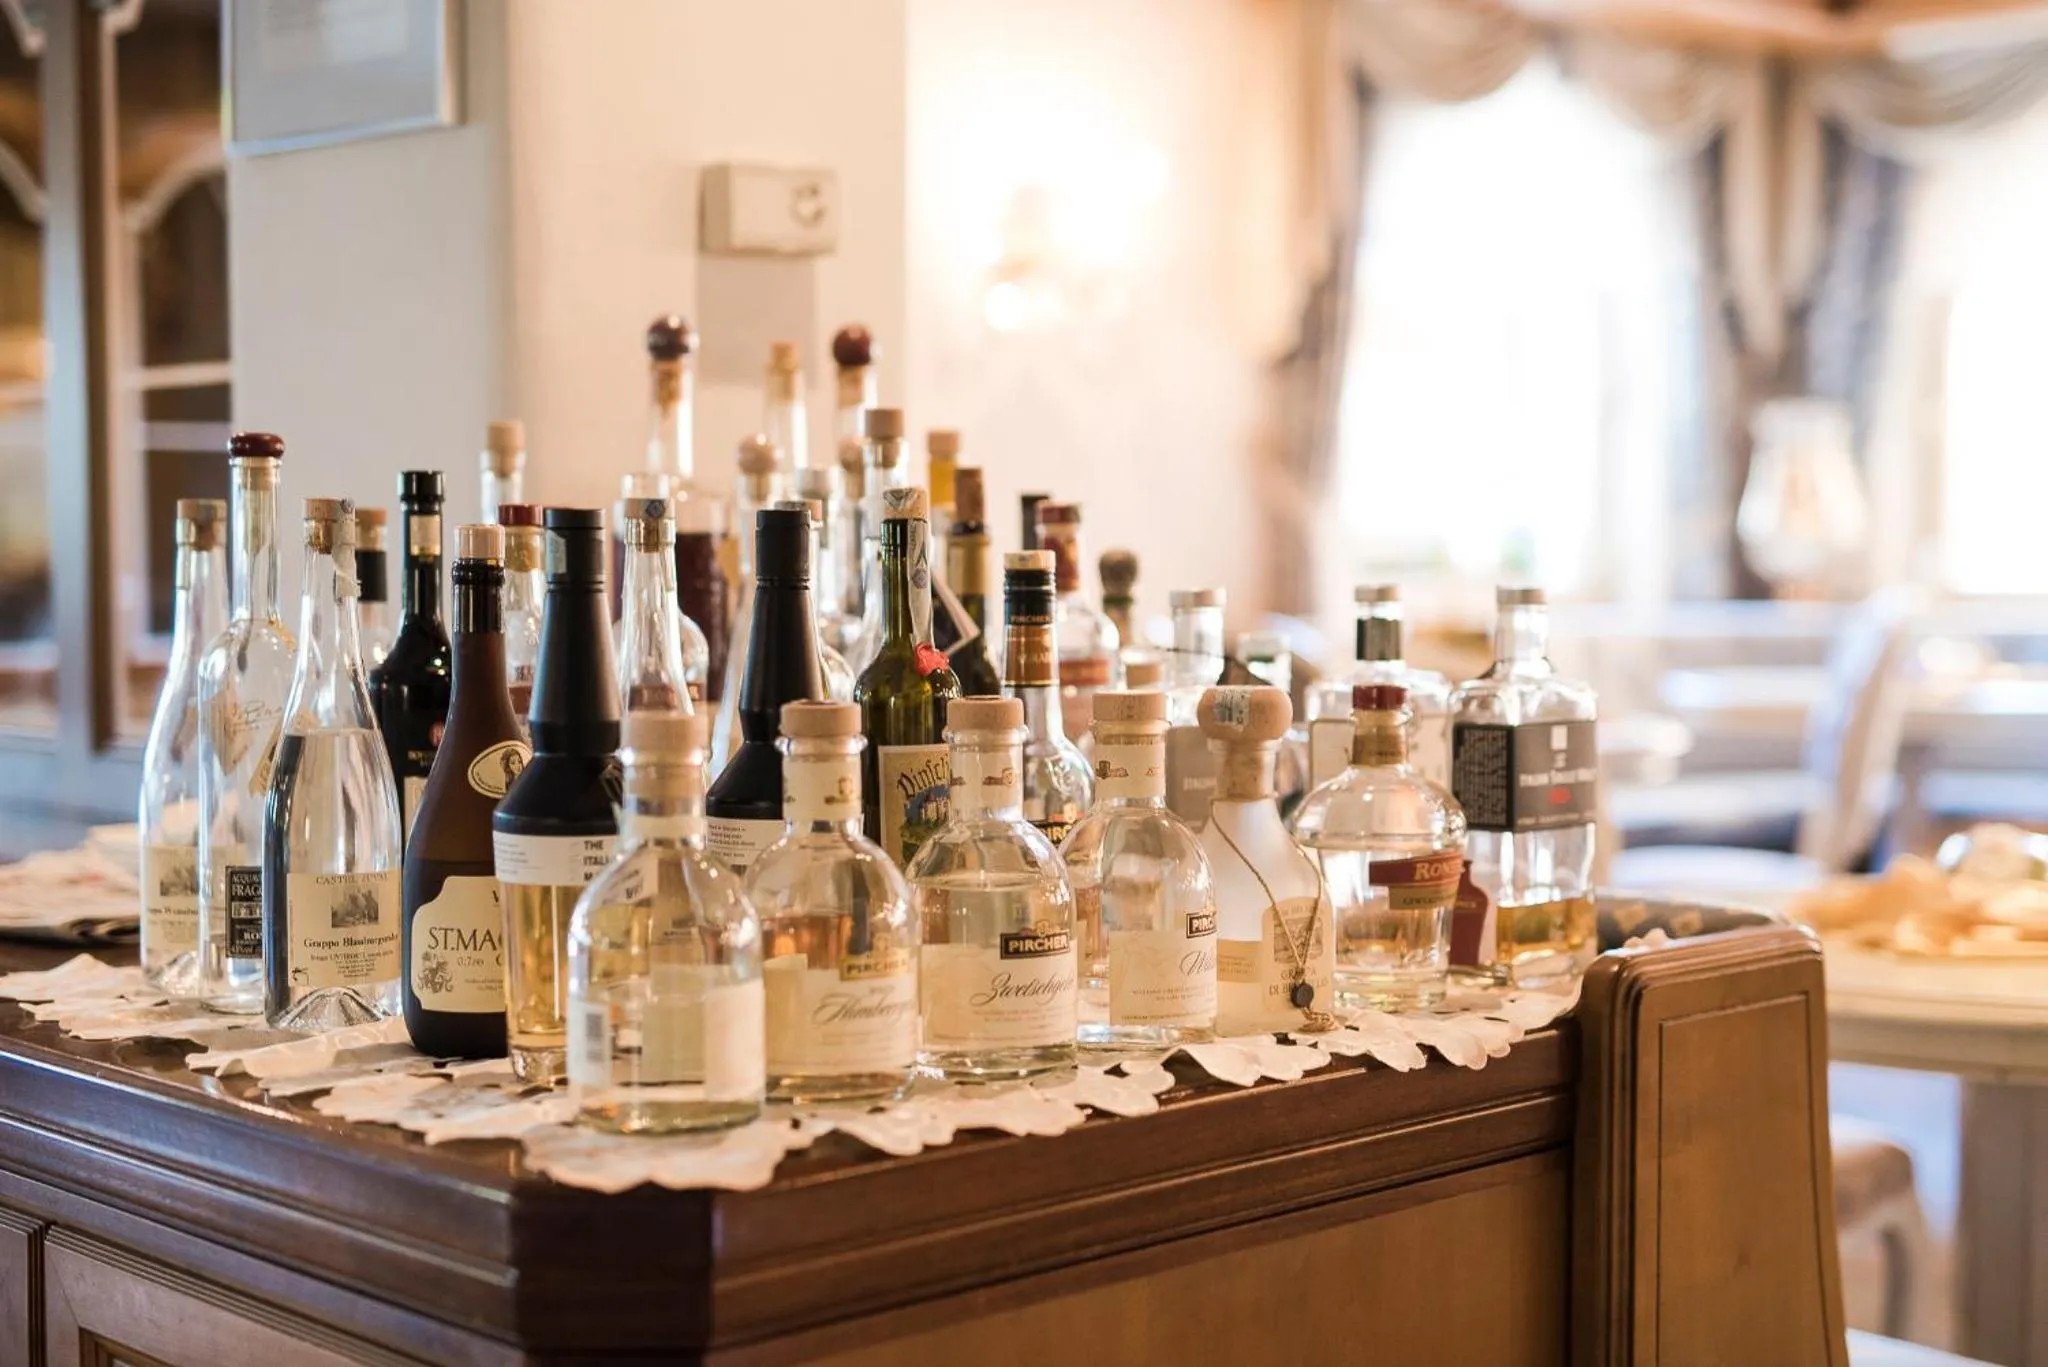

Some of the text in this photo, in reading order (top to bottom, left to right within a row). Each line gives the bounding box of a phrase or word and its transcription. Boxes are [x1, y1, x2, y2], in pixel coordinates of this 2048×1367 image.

[584, 840, 604, 850] THE
[1191, 916, 1216, 932] PIRC
[303, 939, 340, 949] Grappa
[427, 926, 503, 952] ST.MA
[1008, 934, 1069, 953] PIRCHER
